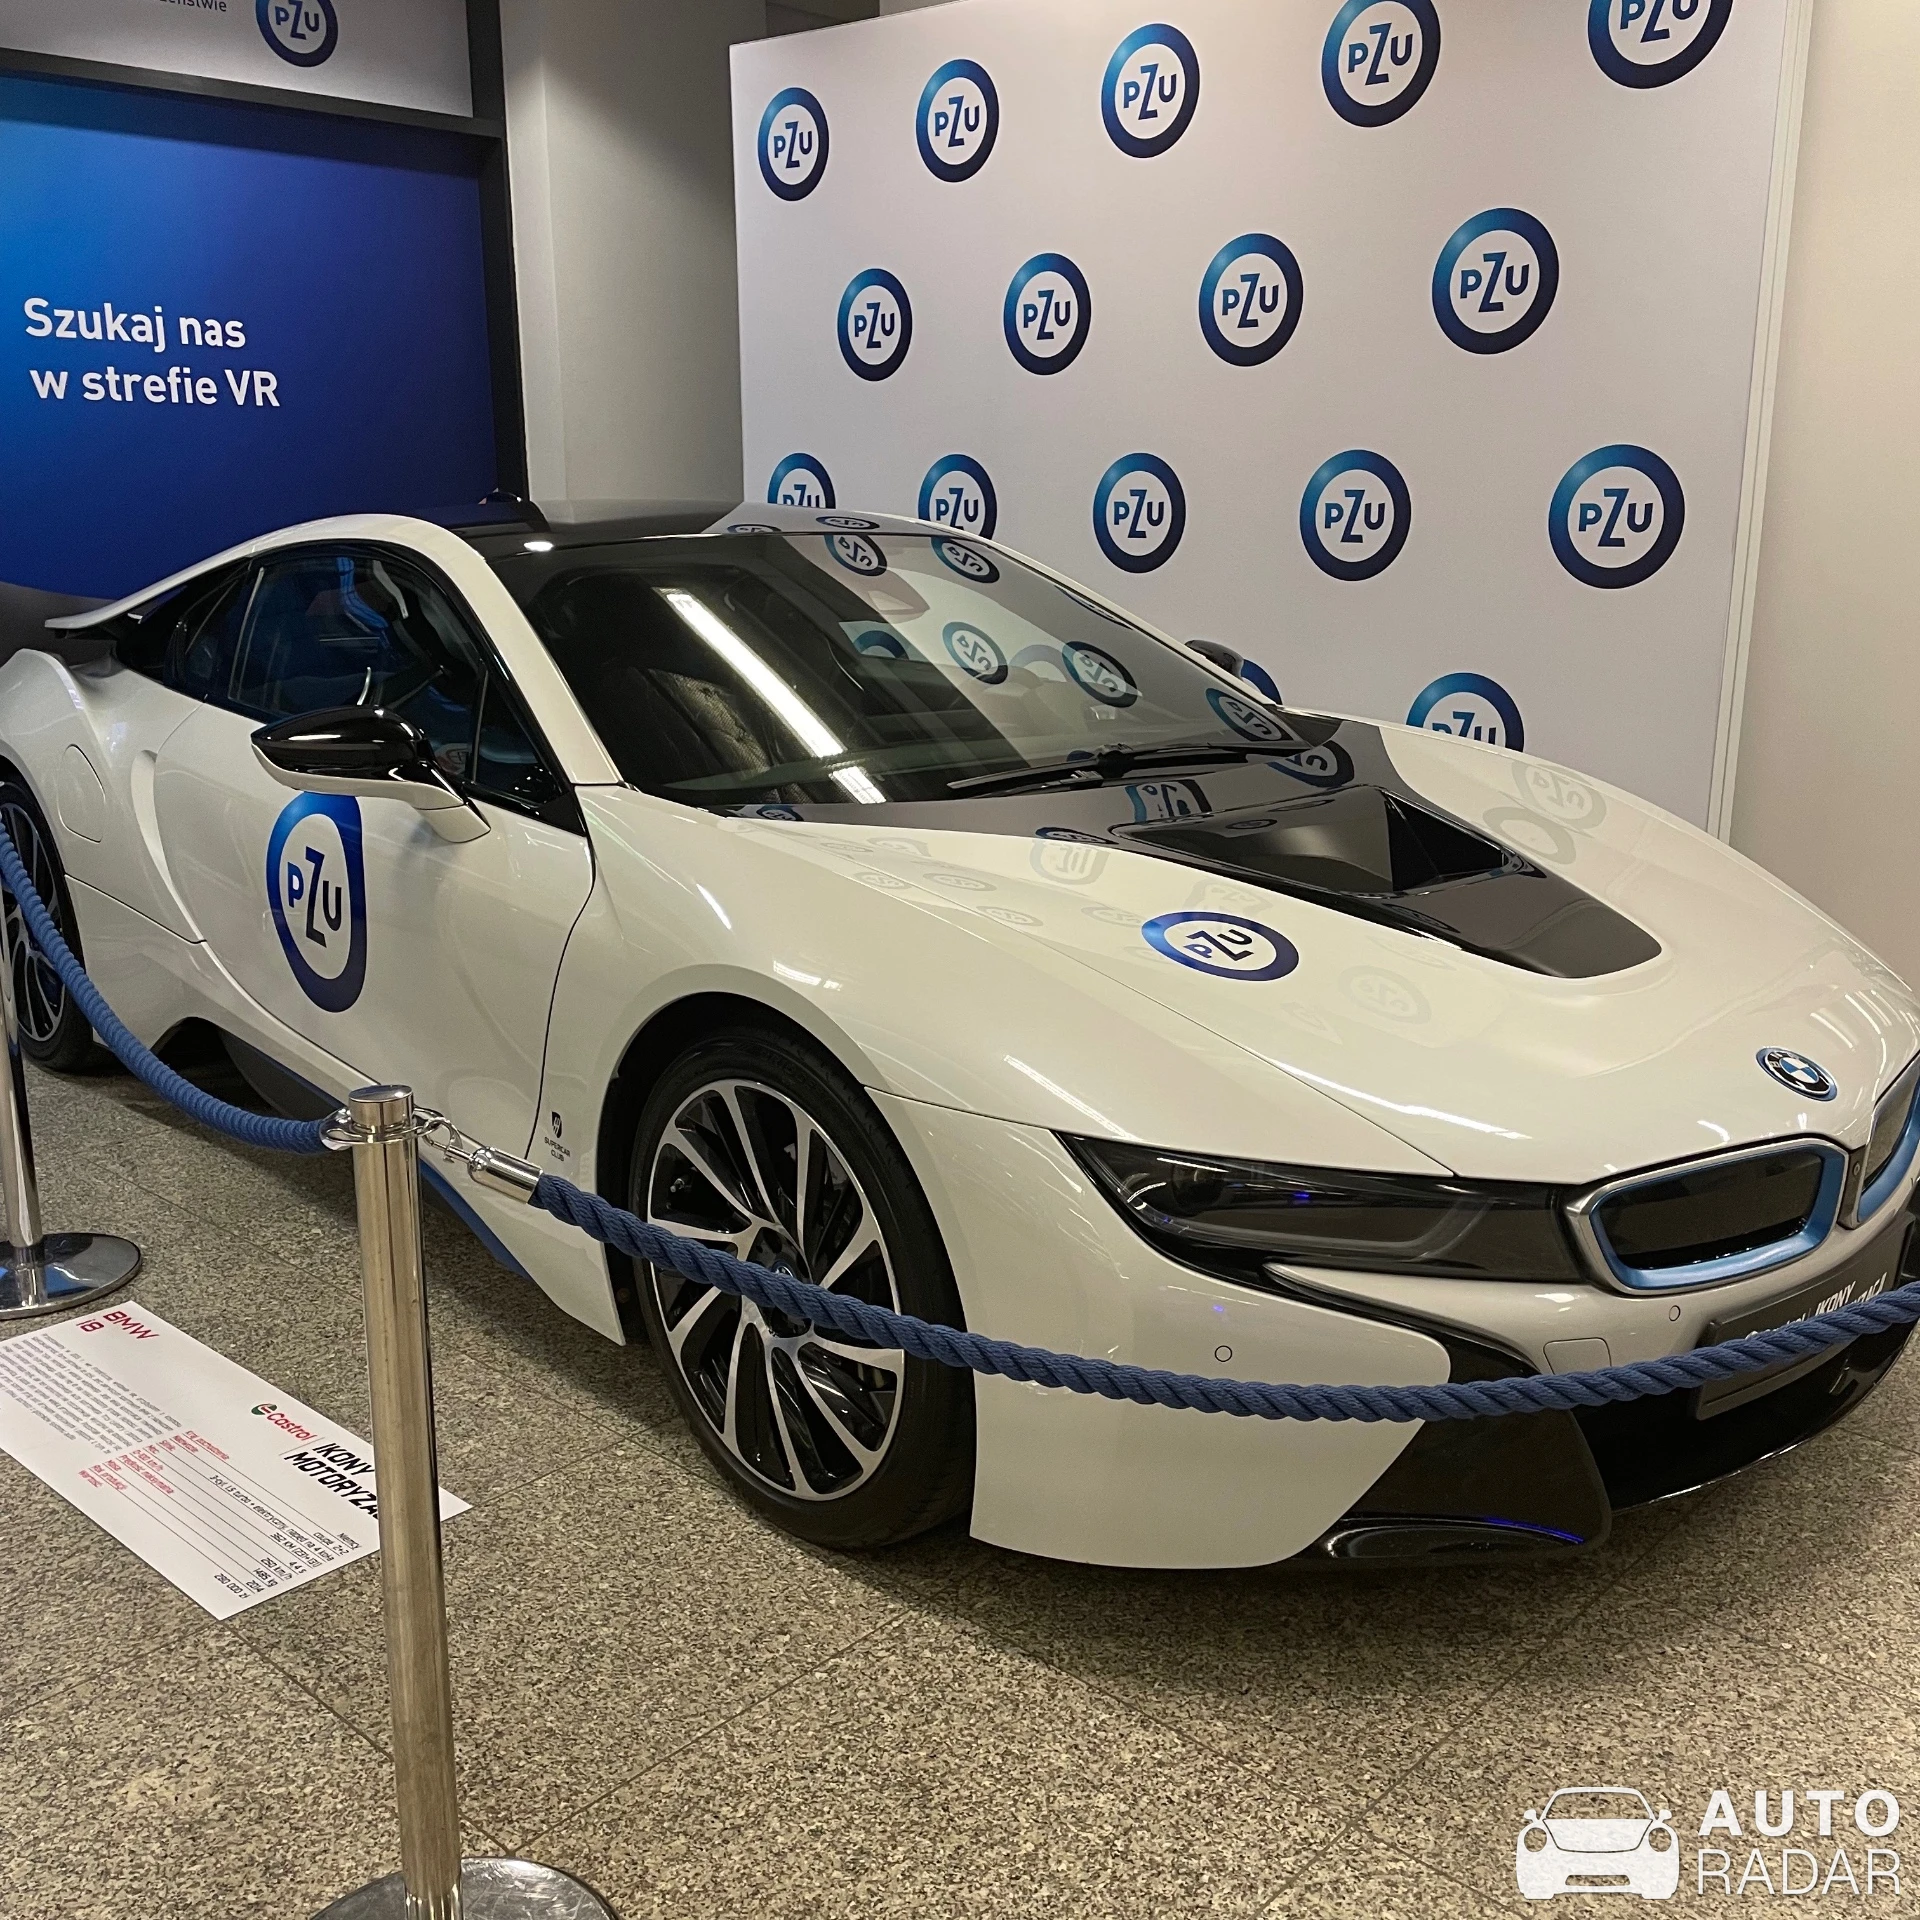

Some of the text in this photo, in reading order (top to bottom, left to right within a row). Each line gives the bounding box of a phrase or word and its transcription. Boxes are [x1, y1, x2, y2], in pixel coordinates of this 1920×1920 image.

[275, 0, 319, 40] PZU
[1620, 0, 1698, 43] PZU
[1348, 23, 1413, 85] PZU
[1124, 64, 1176, 120] PZU
[774, 121, 812, 168] PZU
[935, 96, 979, 147] PZU
[1222, 273, 1279, 328] PZU
[1460, 252, 1529, 312] PZU
[23, 297, 246, 353] Szukaj nas
[854, 302, 894, 348] PZU
[1023, 290, 1070, 340] PZU
[30, 364, 280, 407] w strefie VR
[936, 487, 979, 530] PZU
[1114, 490, 1164, 538] PZU
[1325, 490, 1385, 543] PZU
[1579, 489, 1653, 547] PZU
[288, 846, 341, 948] PZU
[1183, 929, 1253, 961] PZU
[76, 1319, 104, 1332] i8
[103, 1311, 159, 1339] BMW
[267, 1413, 318, 1441] Castrol
[312, 1443, 375, 1475] IKONY
[283, 1452, 379, 1520] MOTORYZA
